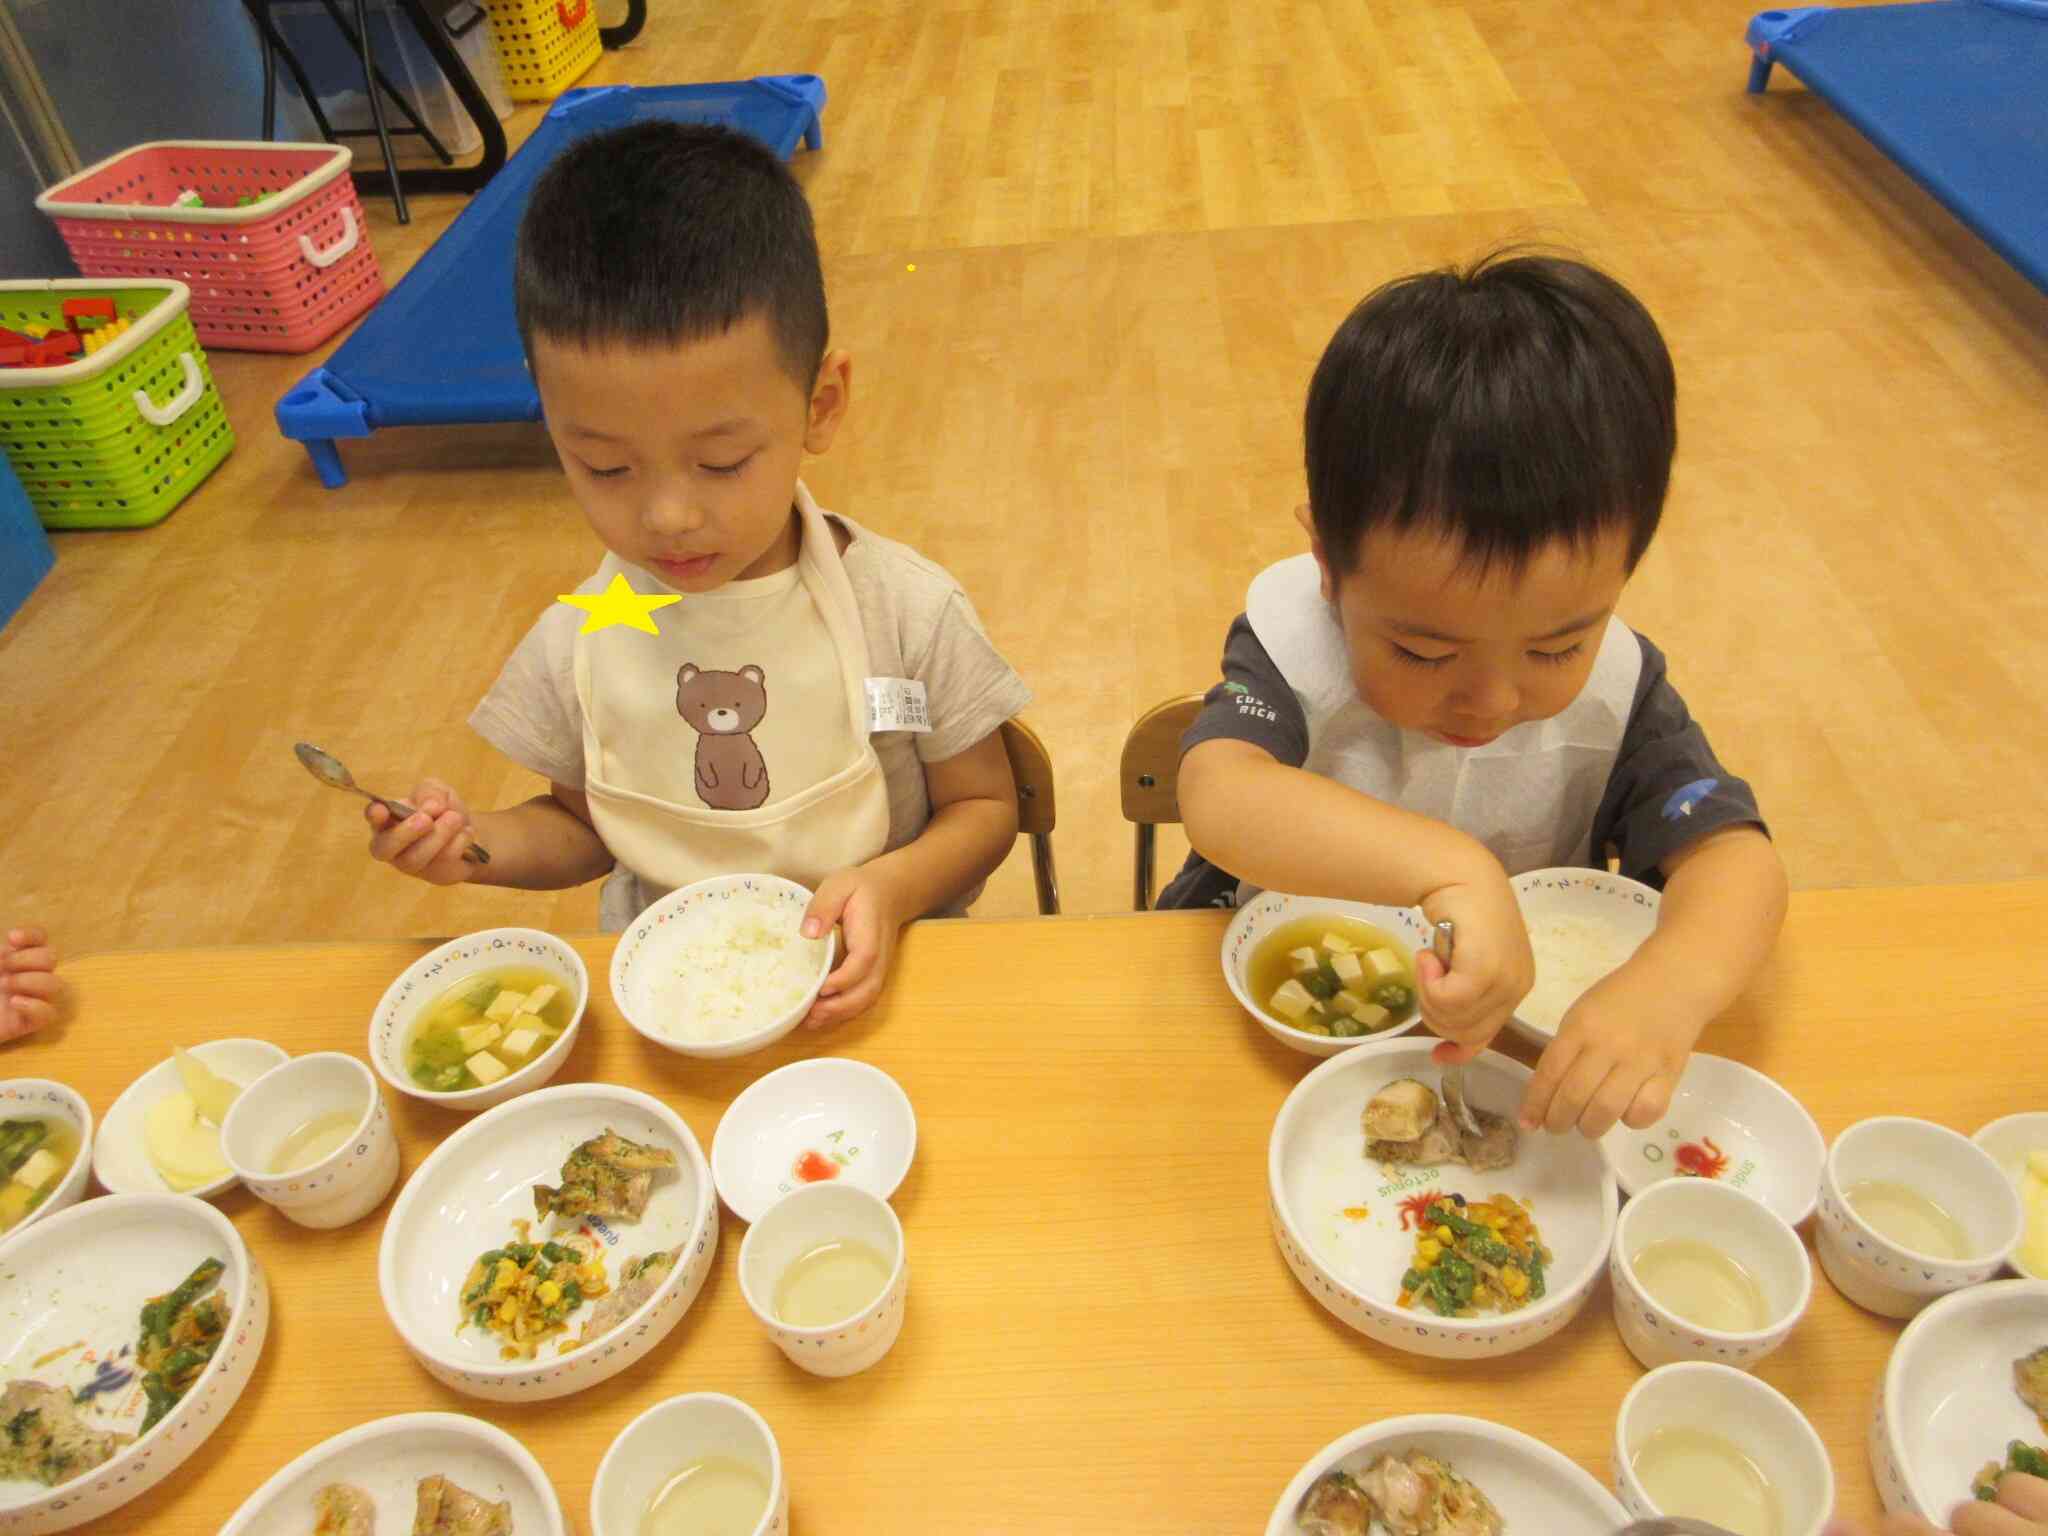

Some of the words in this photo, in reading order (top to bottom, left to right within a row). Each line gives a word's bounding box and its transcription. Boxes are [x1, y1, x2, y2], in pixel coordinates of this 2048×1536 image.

[1239, 705, 1276, 721] RICA
[431, 963, 443, 975] N
[492, 938, 505, 949] Q
